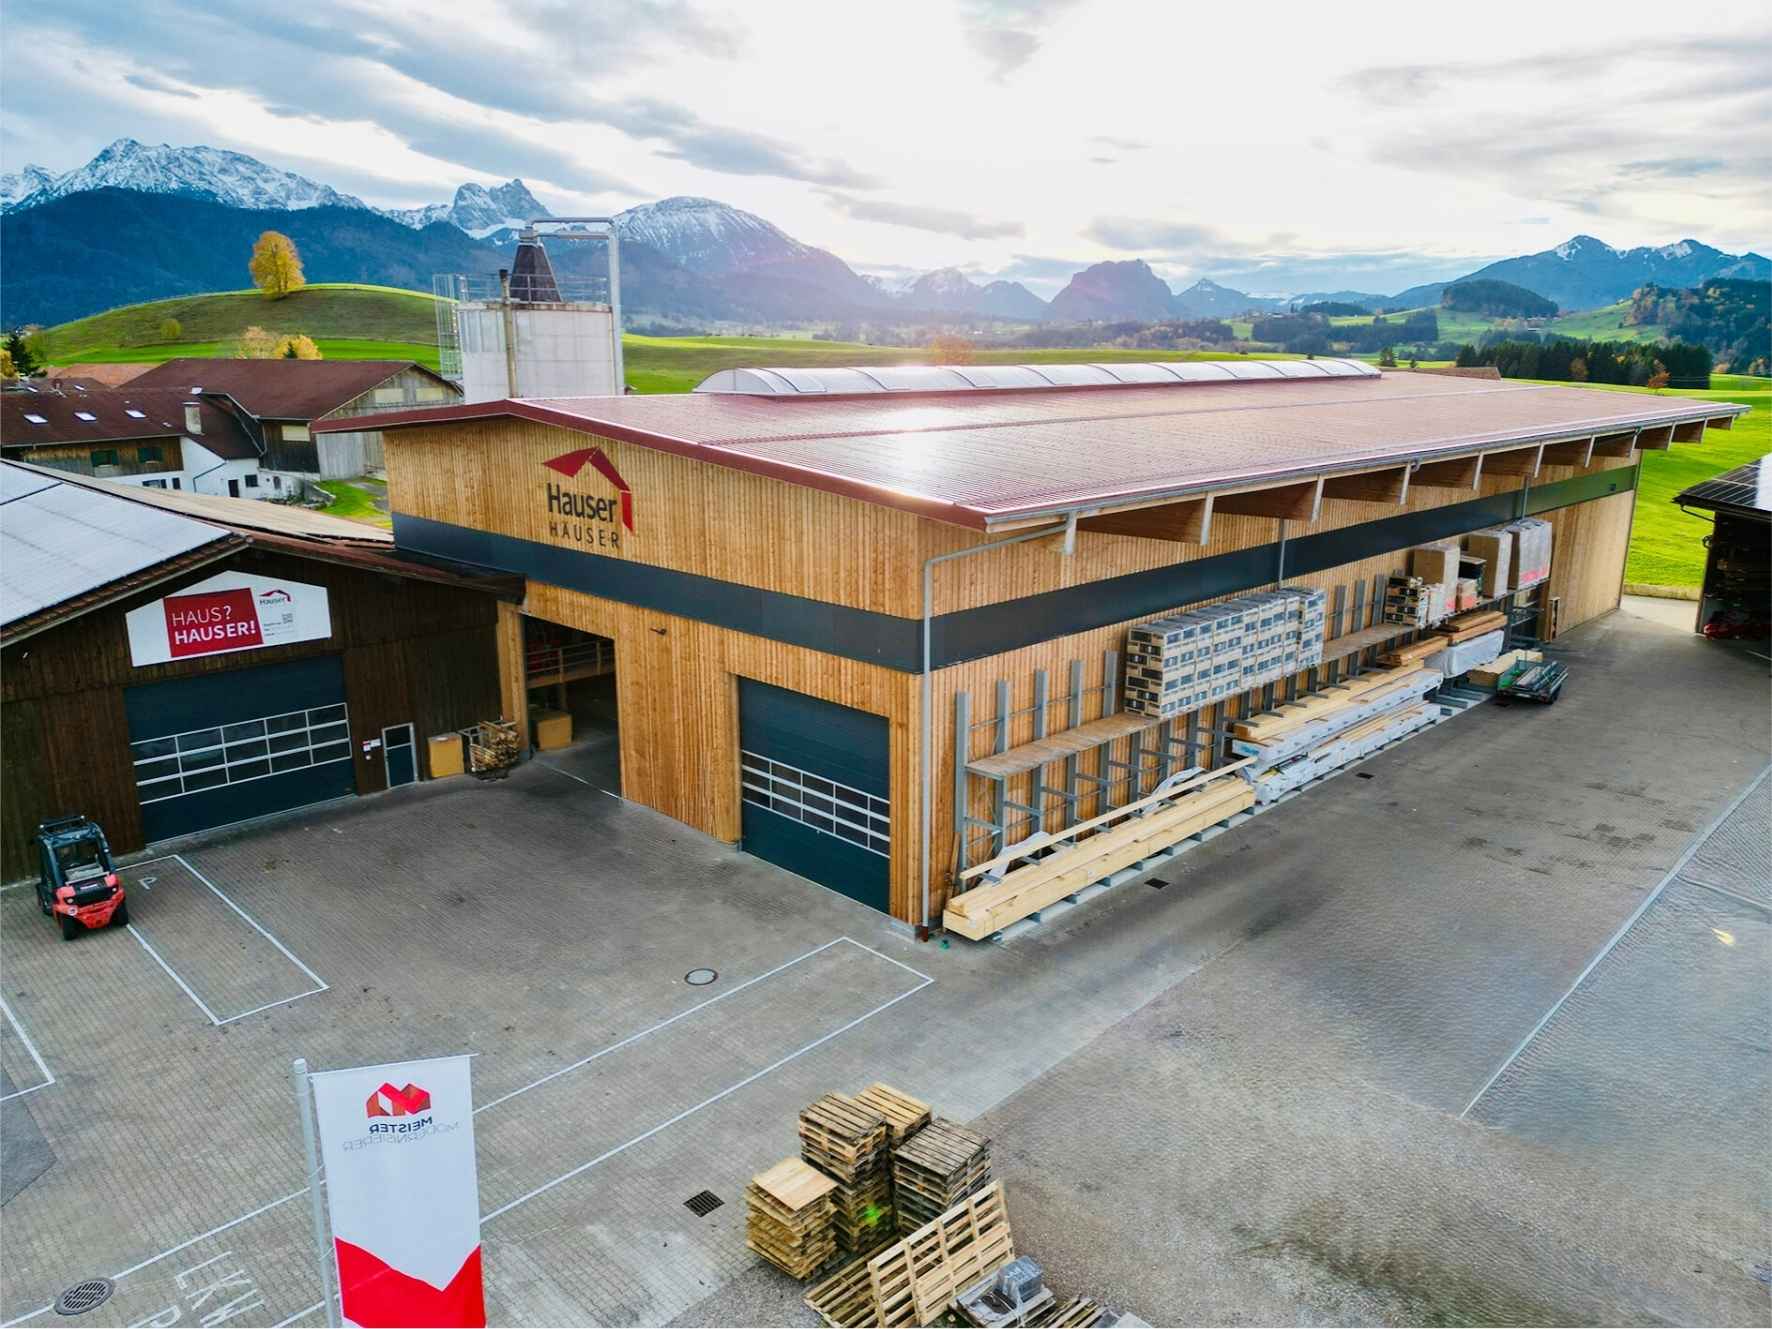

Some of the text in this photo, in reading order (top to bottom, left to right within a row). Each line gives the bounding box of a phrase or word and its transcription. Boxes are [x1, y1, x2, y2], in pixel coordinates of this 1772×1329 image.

[547, 482, 617, 522] Hauser
[171, 605, 232, 627] HAUS?
[174, 620, 256, 645] HAUSER!
